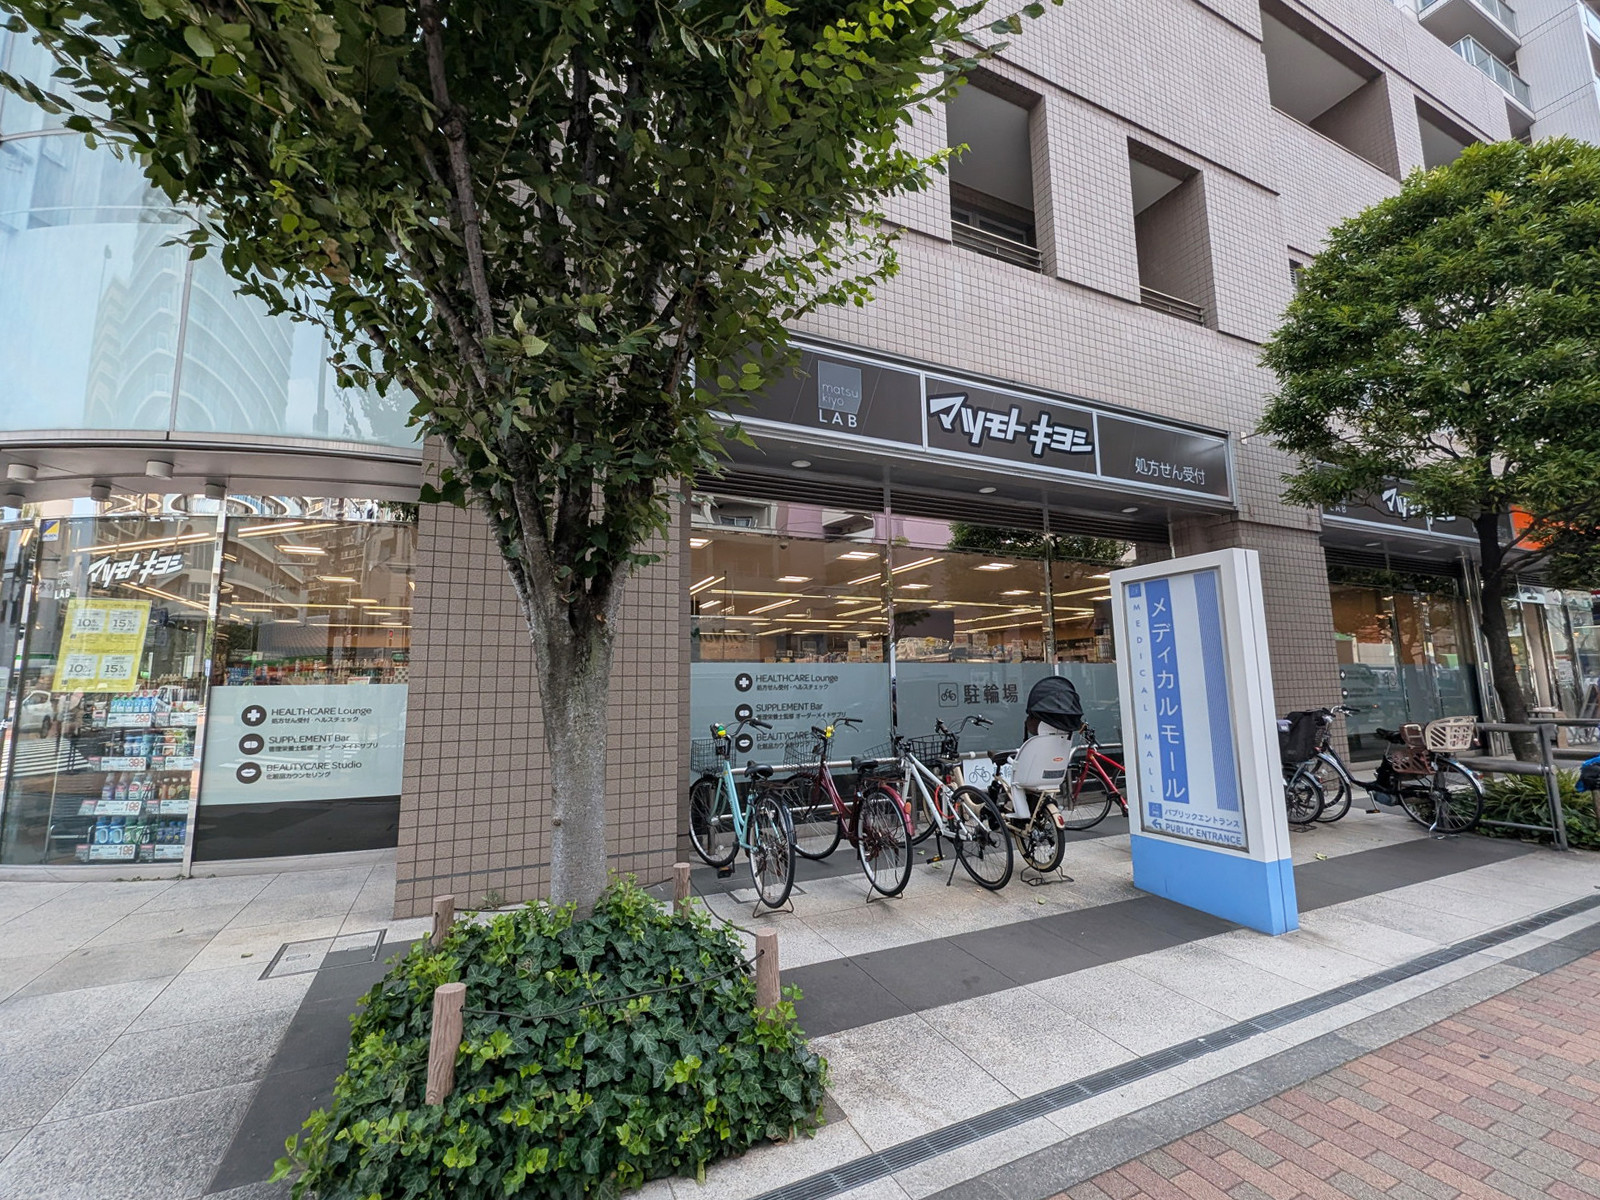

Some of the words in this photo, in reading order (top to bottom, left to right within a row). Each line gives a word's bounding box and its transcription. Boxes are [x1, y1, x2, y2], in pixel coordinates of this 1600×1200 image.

[822, 383, 859, 399] matsu
[822, 394, 845, 411] kiyo
[819, 408, 858, 428] LAB
[928, 395, 1093, 456] マツモトキヨシ
[1134, 456, 1206, 486] 処方せん受付
[54, 588, 71, 600] LAB
[756, 673, 810, 682] HEALTHCARE
[811, 674, 838, 684] Lounge
[963, 683, 1019, 705] 駐輪場
[1151, 596, 1186, 799] メディカルモール
[271, 707, 336, 717] HEALTHCARE
[338, 707, 373, 716] Lounge
[756, 702, 810, 712] SUPPLEMENT
[810, 702, 823, 710] Bar
[268, 735, 333, 744] SUPPLEMENT
[334, 734, 350, 742] Bar
[756, 731, 810, 741] BEAUTYCARE
[266, 762, 331, 772] BEAUTYCARE
[331, 761, 362, 769] Studio
[1165, 808, 1240, 828] パブリックエントランス
[1165, 822, 1194, 837] PUBLIC
[1196, 829, 1243, 846] ENTRANCE
